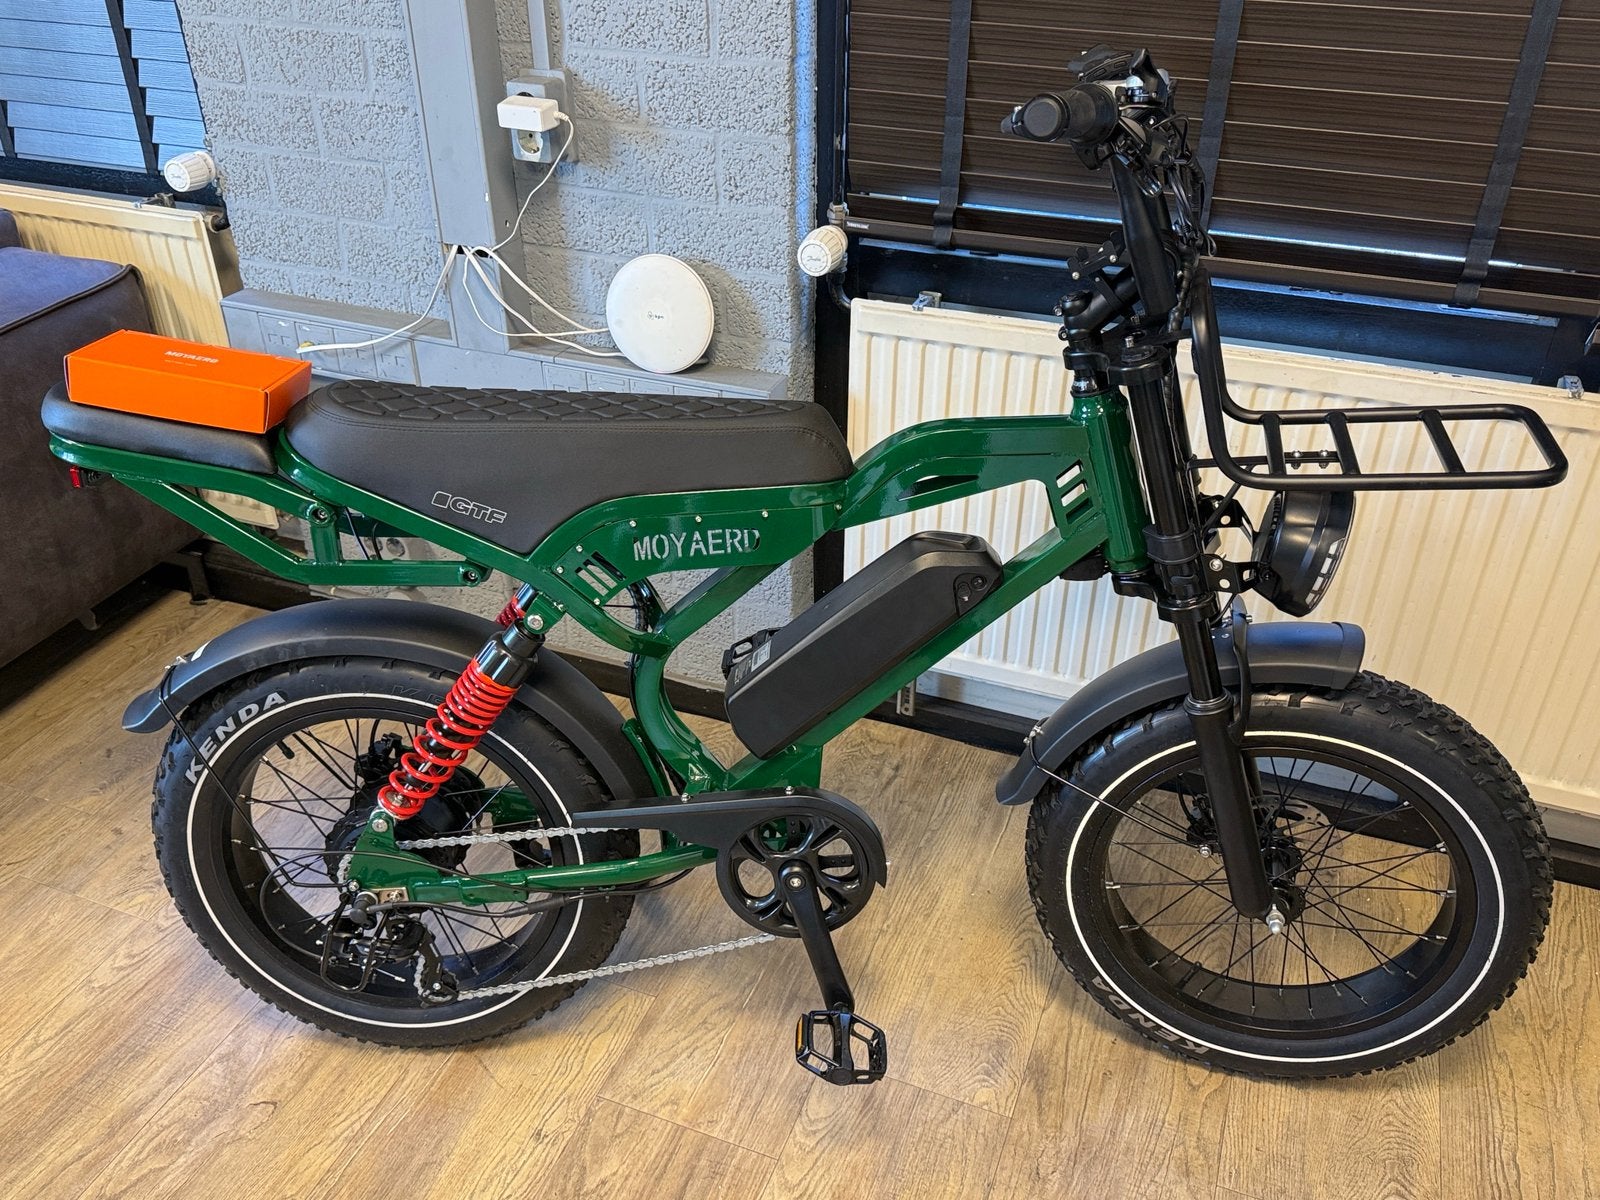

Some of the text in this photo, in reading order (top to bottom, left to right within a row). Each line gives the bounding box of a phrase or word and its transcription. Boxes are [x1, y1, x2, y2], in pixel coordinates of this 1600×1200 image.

[450, 496, 508, 523] GTF
[184, 691, 287, 785] KENDA
[1091, 975, 1210, 1055] KENDA
